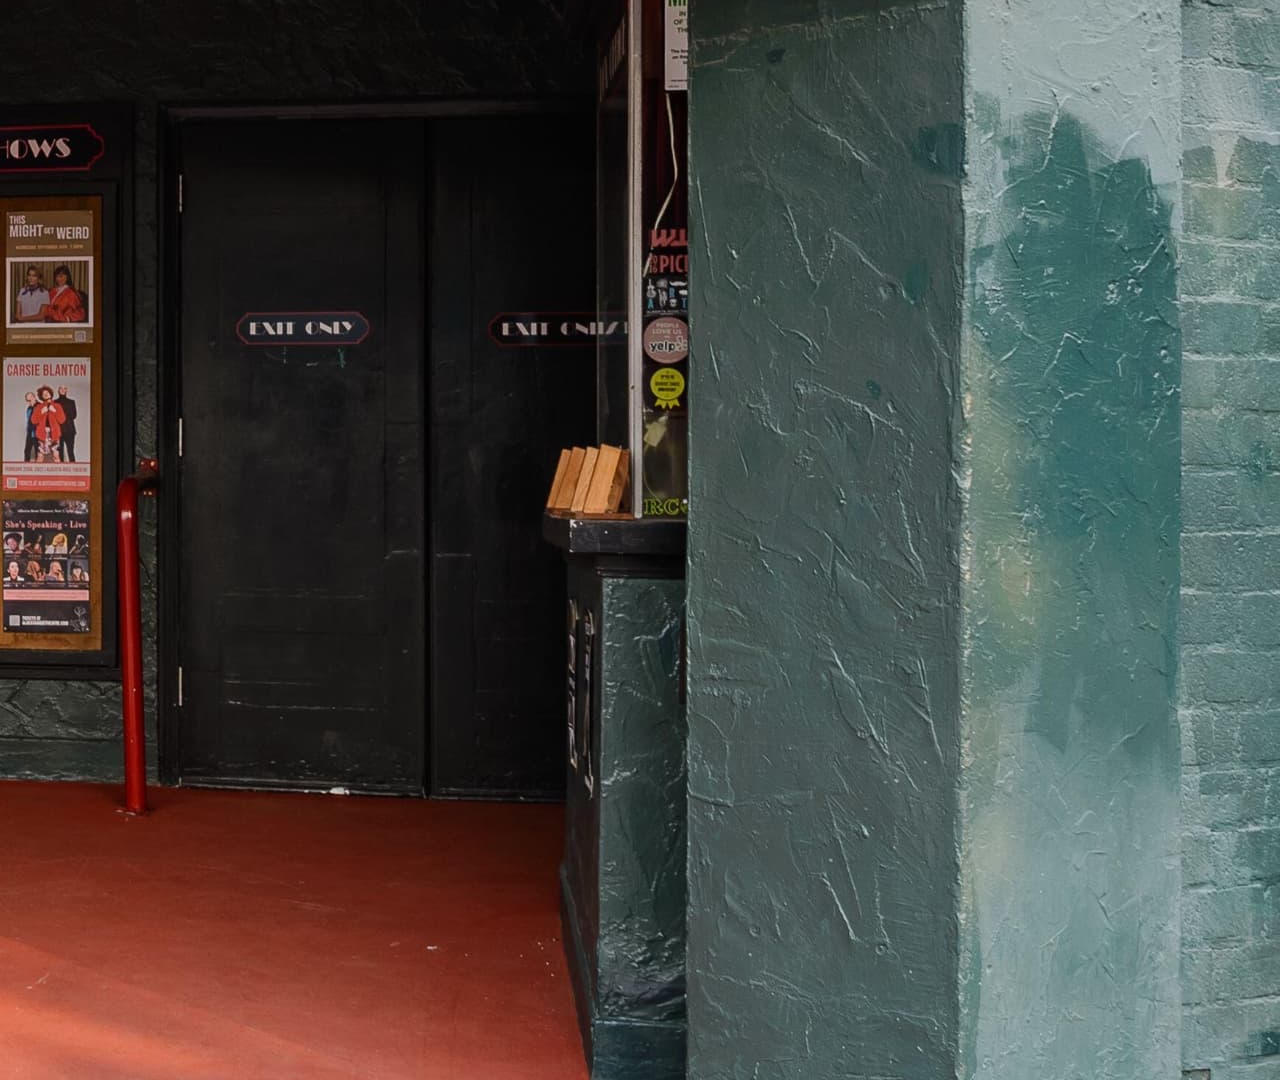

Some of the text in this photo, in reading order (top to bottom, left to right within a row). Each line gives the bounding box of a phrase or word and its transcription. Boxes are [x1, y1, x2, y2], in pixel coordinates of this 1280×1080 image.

[9, 215, 26, 224] THIS
[9, 224, 44, 238] MIGHT
[56, 226, 89, 240] WEIRD
[249, 321, 356, 336] EXIT ONLY
[501, 321, 550, 337] EXIT
[650, 341, 676, 353] yelp
[7, 364, 87, 377] CARSIE BLANTON
[27, 520, 62, 531] Speaking
[69, 520, 87, 529] Live
